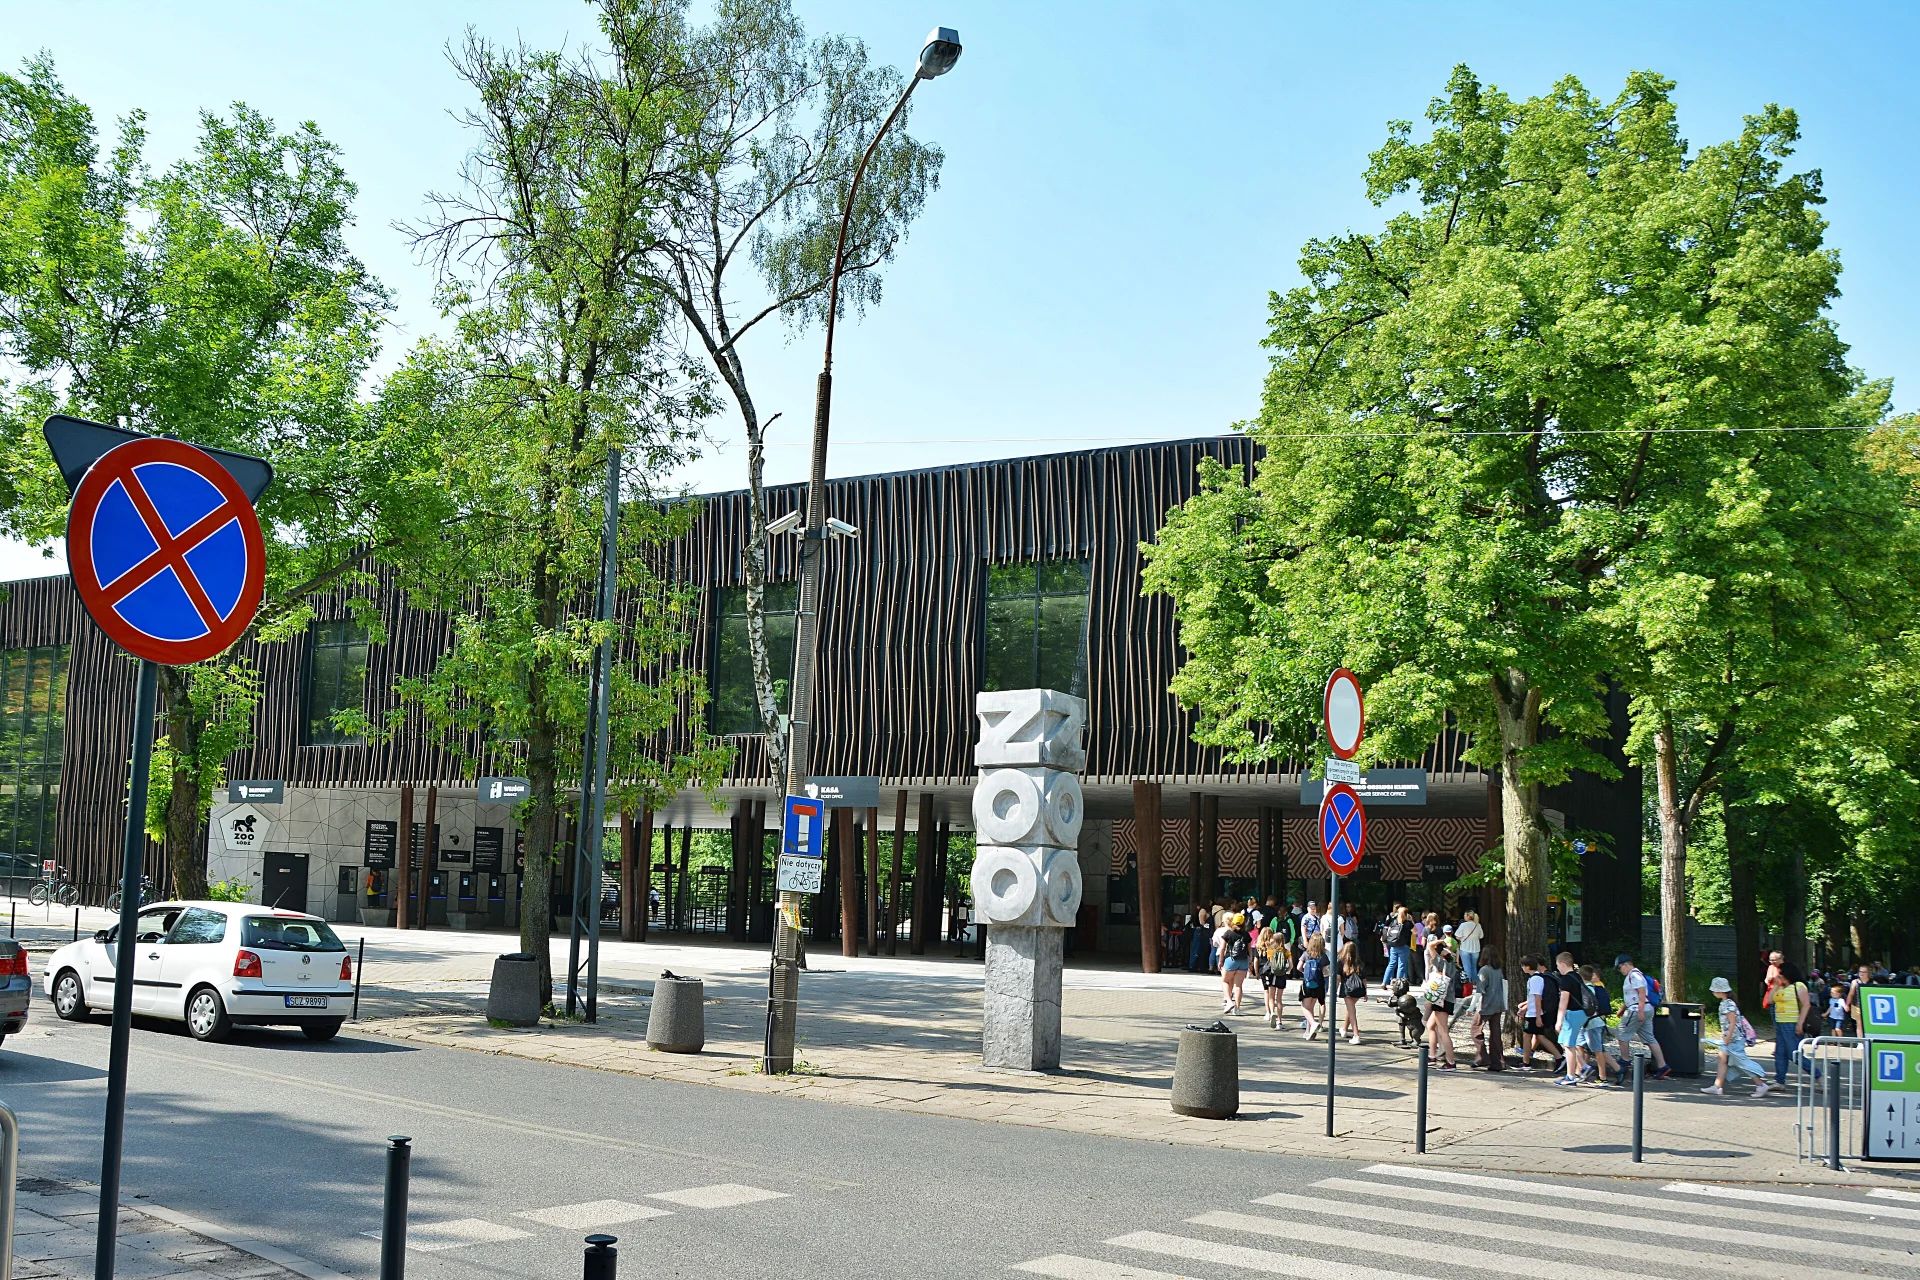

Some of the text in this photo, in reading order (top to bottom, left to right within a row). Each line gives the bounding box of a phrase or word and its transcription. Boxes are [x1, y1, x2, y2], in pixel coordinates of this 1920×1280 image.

[234, 833, 255, 841] ZOO
[781, 858, 822, 872] Nie dotyczy
[290, 996, 326, 1006] SCZ 98993
